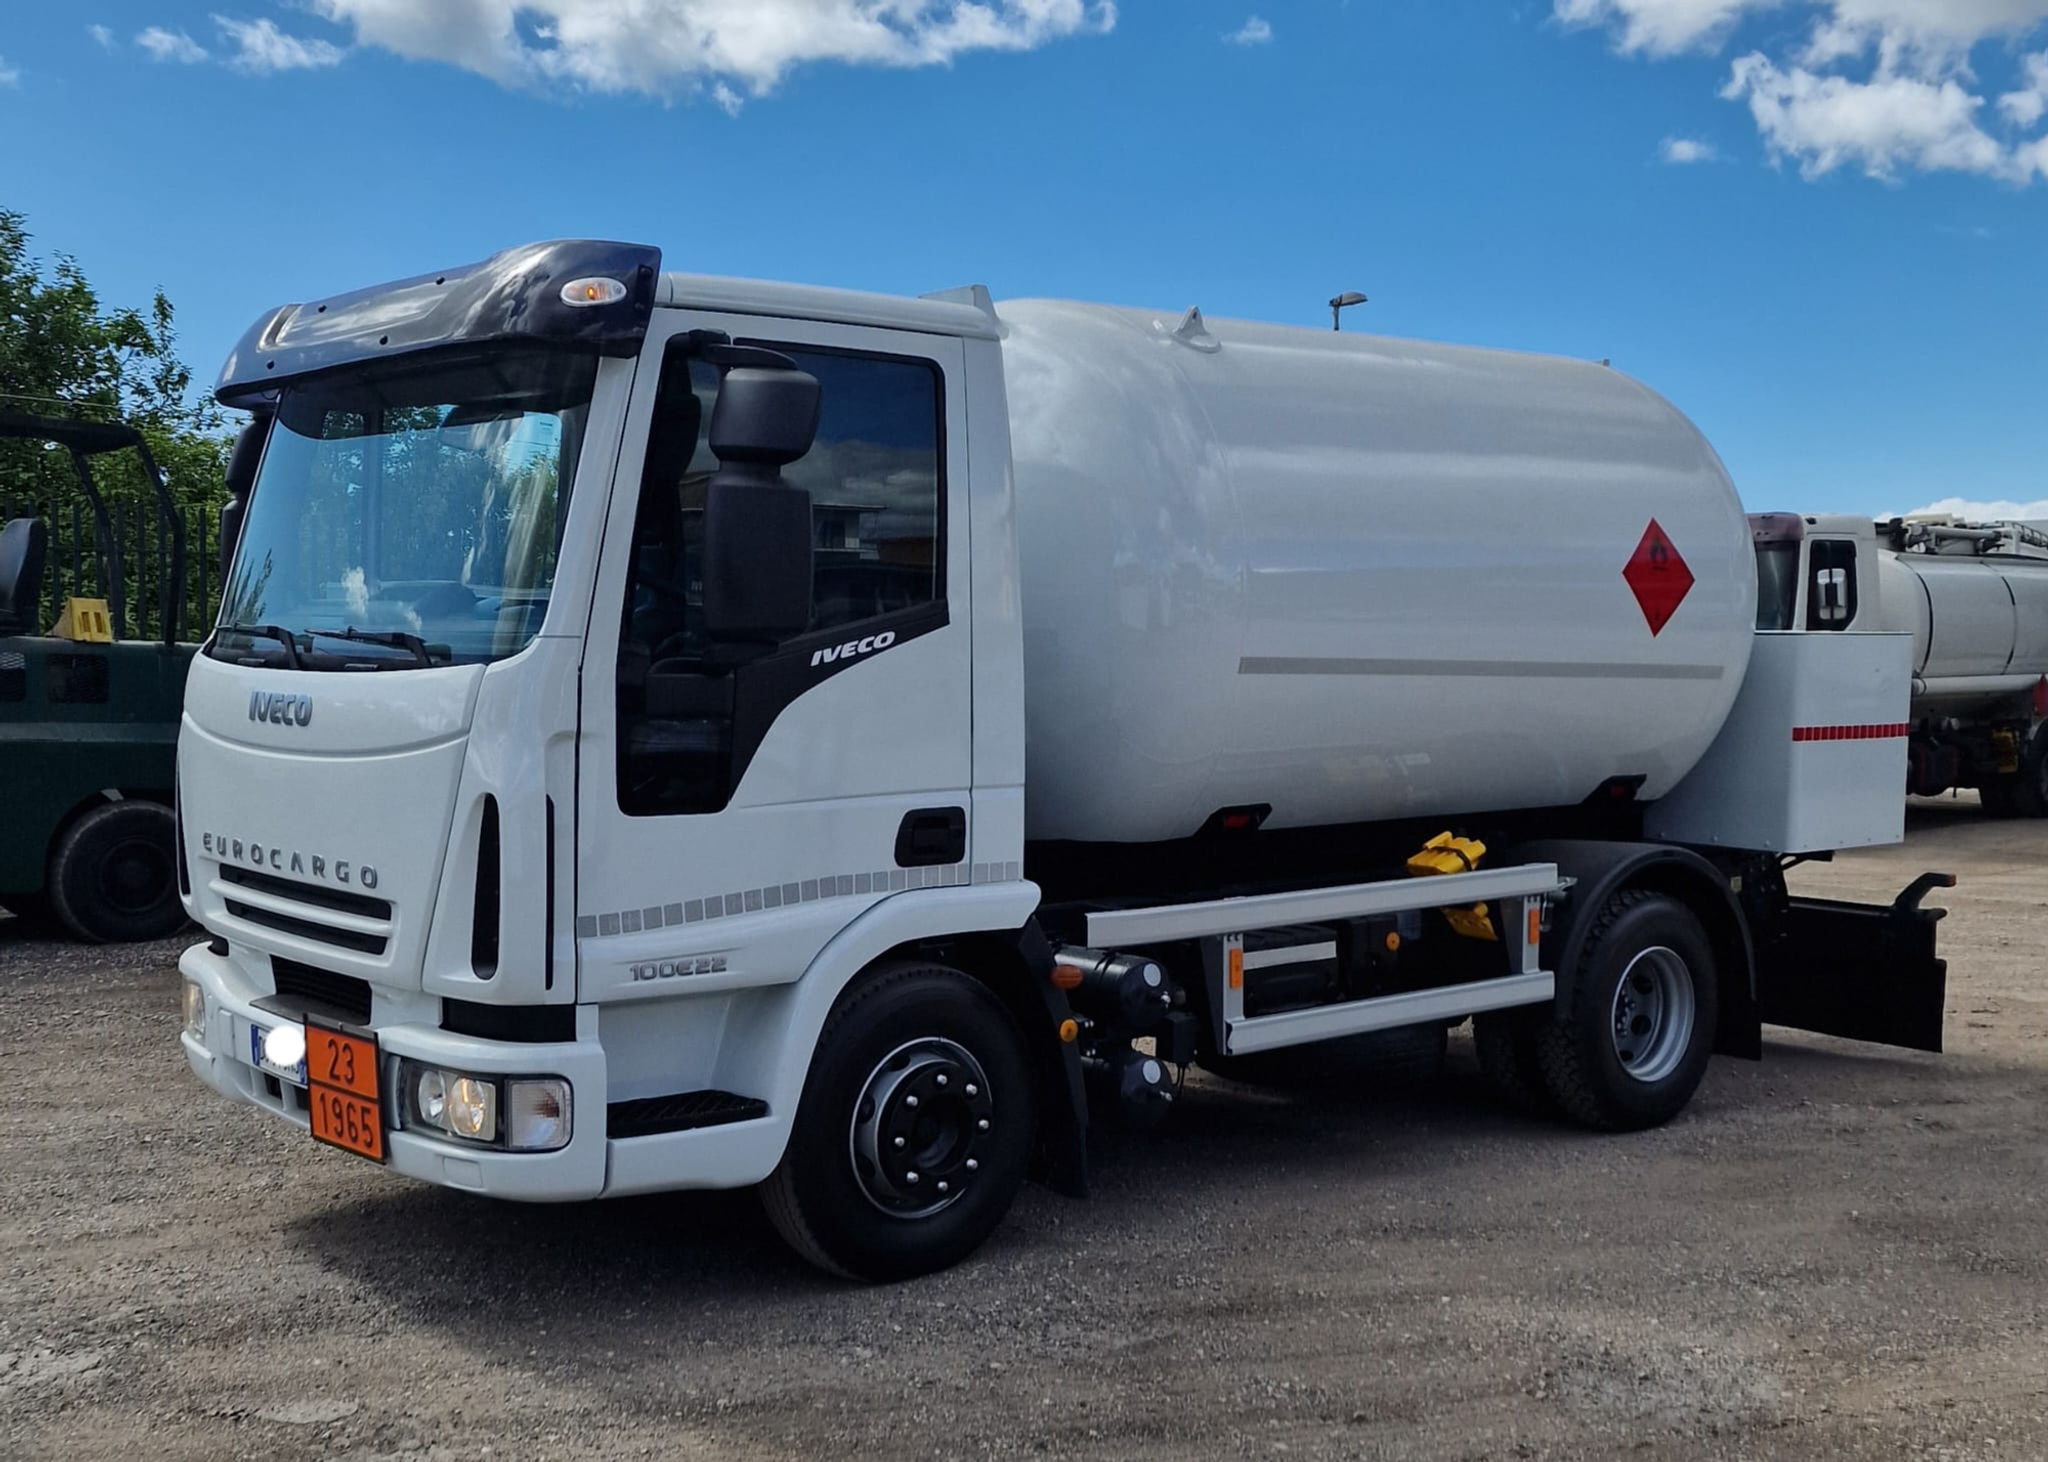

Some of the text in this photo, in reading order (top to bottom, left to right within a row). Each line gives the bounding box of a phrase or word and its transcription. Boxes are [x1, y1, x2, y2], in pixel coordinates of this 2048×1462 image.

[810, 631, 896, 667] IVECO
[248, 690, 313, 727] IVECO
[202, 832, 378, 889] EUROCARGO
[629, 956, 727, 982] 100E22
[327, 1038, 355, 1084] 23
[319, 1092, 374, 1149] 1965
